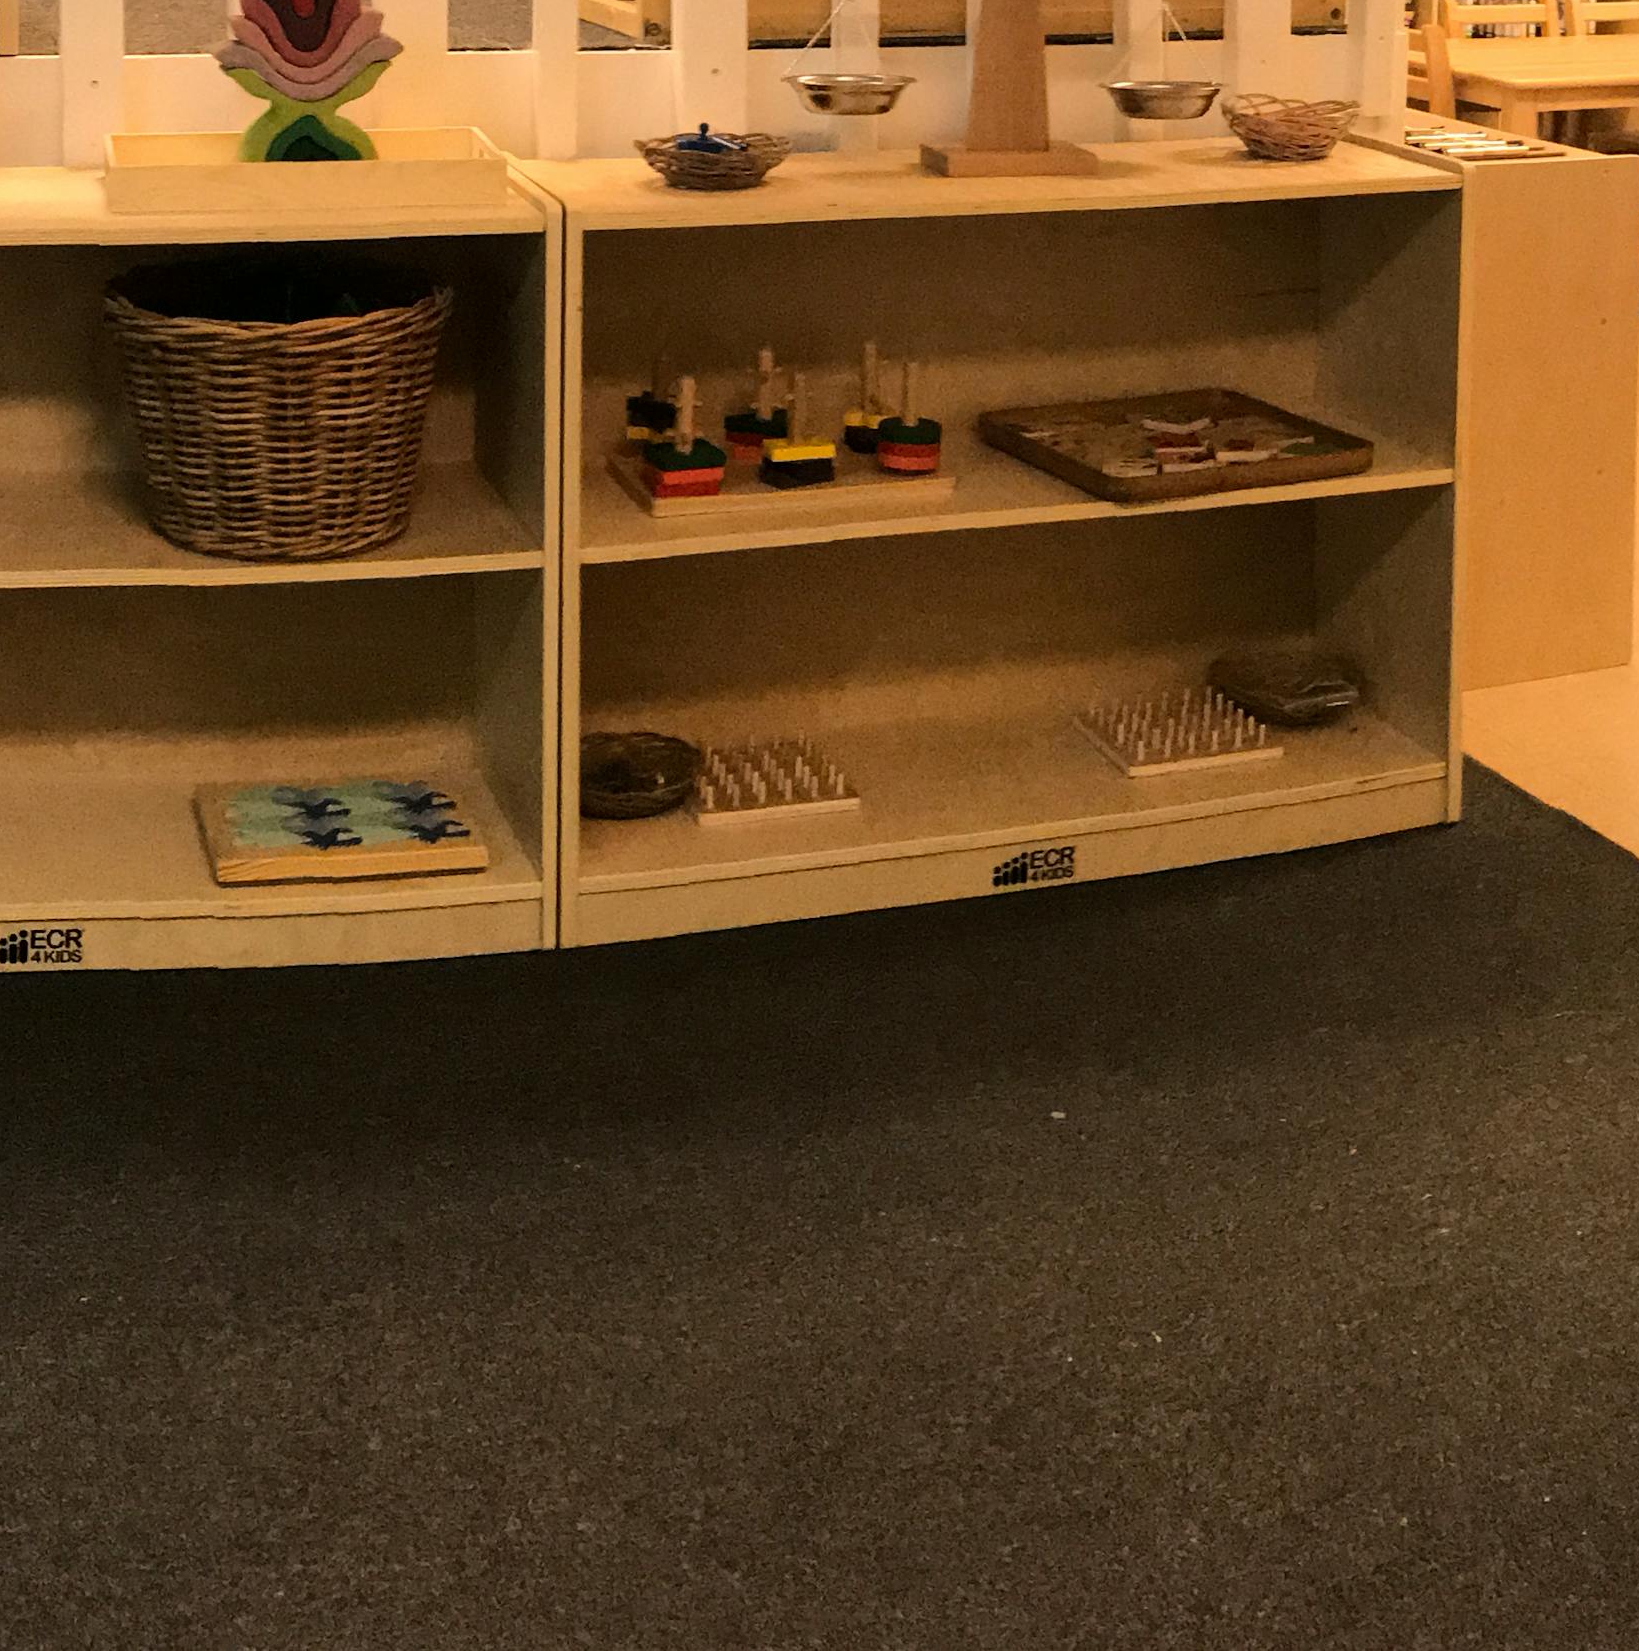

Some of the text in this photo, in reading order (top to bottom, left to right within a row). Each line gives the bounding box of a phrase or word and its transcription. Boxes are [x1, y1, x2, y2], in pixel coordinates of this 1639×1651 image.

[1030, 846, 1075, 870] ECR
[1041, 865, 1074, 881] KIDS
[30, 928, 83, 950] ECR
[30, 949, 83, 964] 4 KIDS
